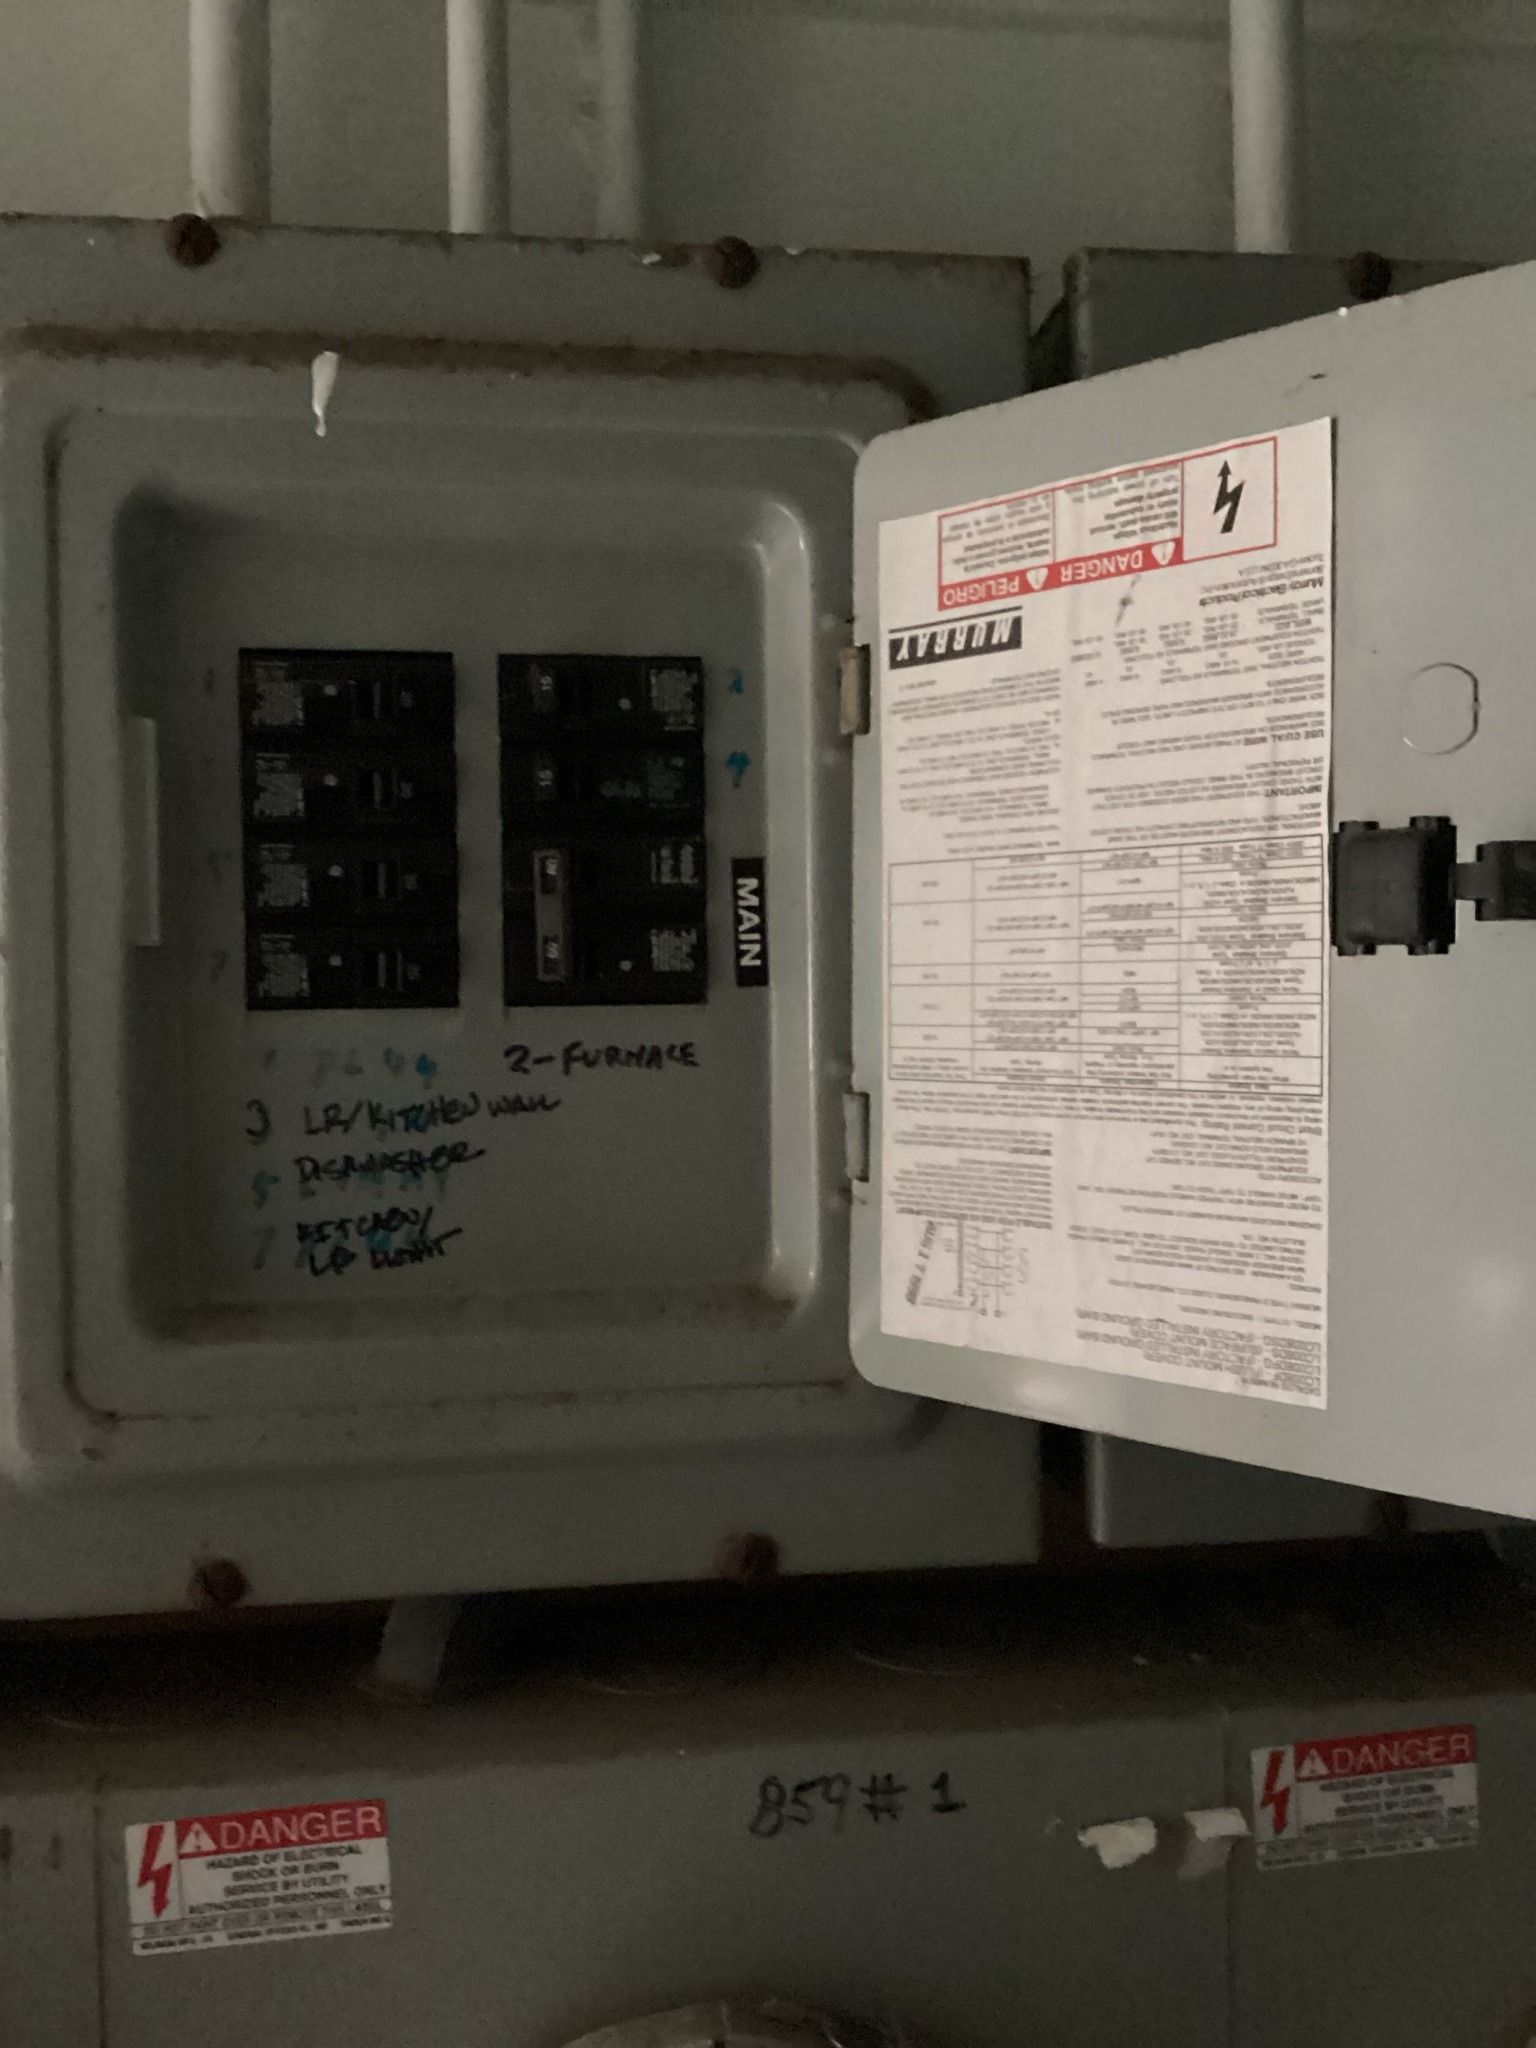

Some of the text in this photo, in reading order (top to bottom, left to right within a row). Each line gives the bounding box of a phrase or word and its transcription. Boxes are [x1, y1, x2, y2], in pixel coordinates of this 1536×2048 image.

[943, 549, 1144, 605] DANGER PELIGRO
[896, 617, 1013, 661] MURRAY
[737, 878, 762, 967] MAIN
[244, 1097, 272, 1145] 3
[1331, 1733, 1470, 1774] DANGER
[219, 1806, 383, 1850] DANGER
[206, 1854, 260, 1870] HAZARD
[283, 1844, 362, 1862] ELECTRICAL
[280, 1864, 299, 1877] OR
[303, 1861, 340, 1875] BURN
[224, 1873, 348, 1897] SERVICE BY UTILITY
[354, 1883, 386, 1896] ONLY
